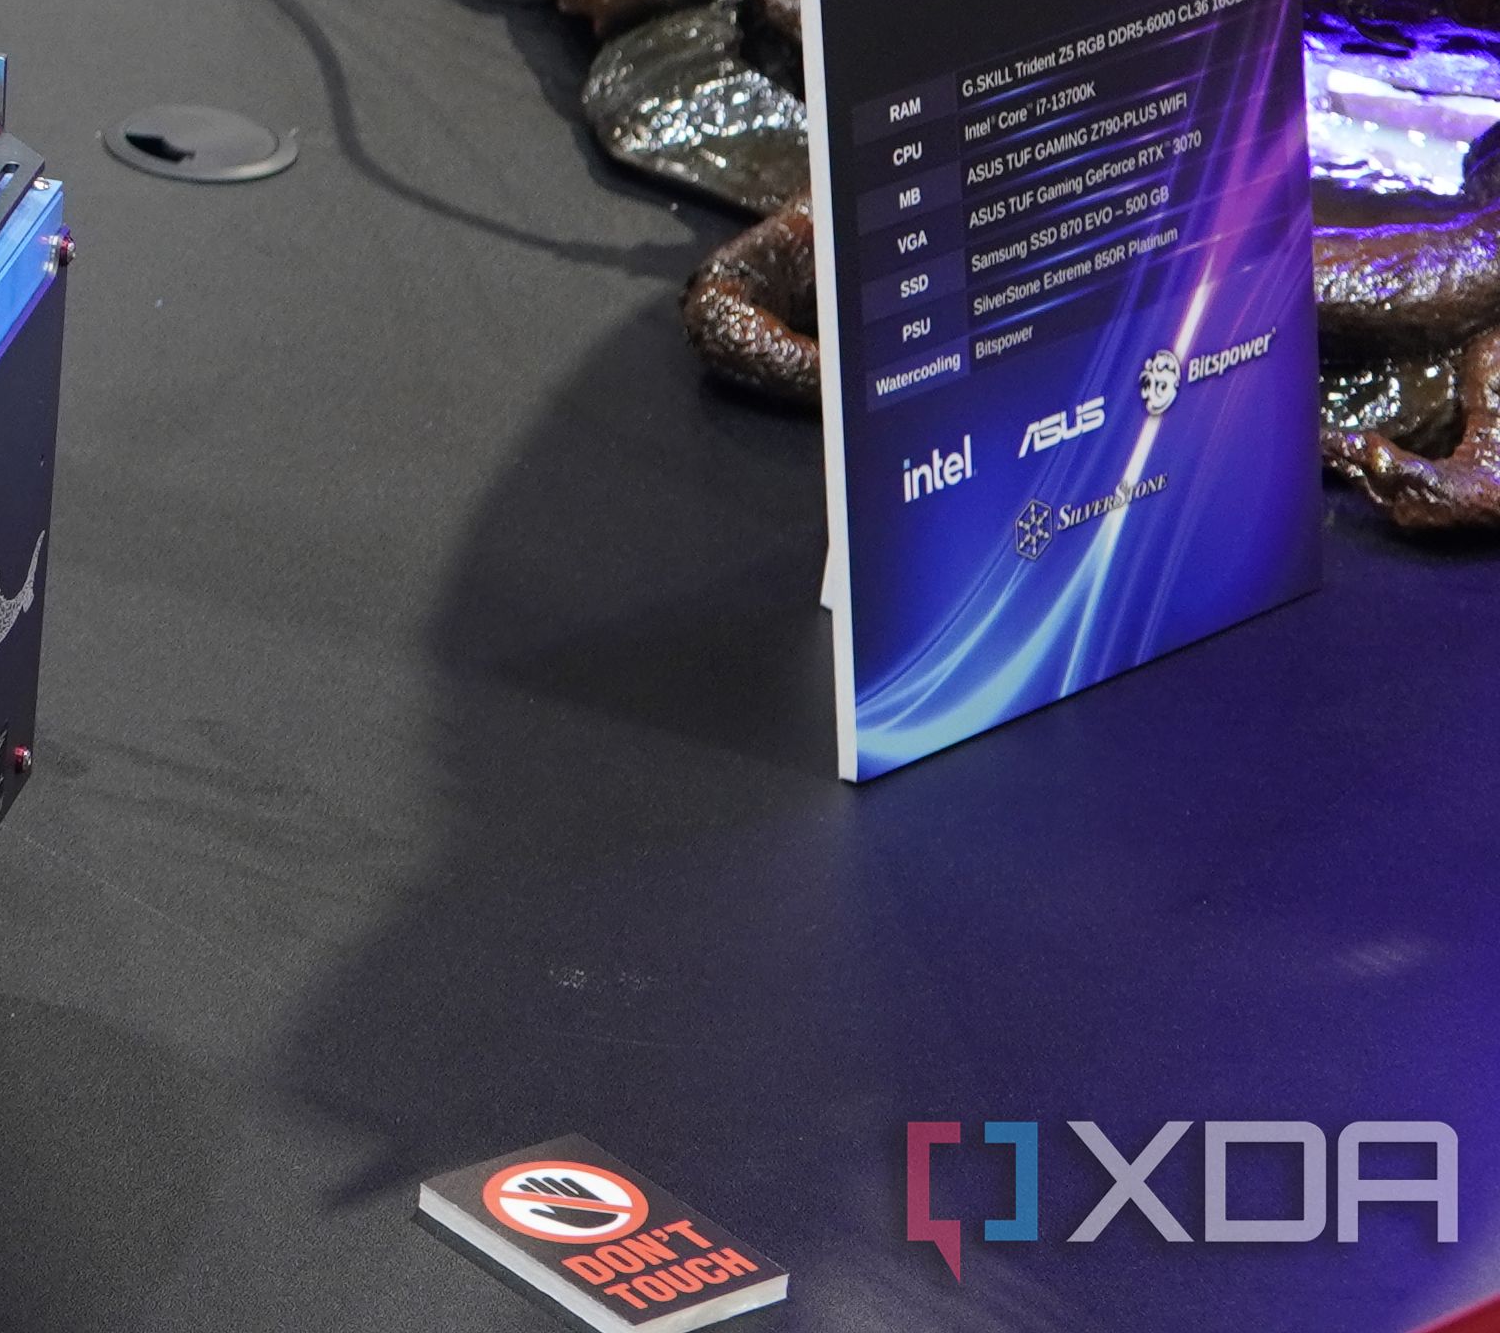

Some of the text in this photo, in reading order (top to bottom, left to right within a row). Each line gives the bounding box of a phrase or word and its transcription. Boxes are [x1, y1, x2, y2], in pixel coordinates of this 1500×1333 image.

[962, 66, 1014, 97] G.SKILL
[1015, 48, 1055, 80] Trident
[1058, 43, 1074, 63] Z5
[1077, 33, 1105, 59] RGB
[1109, 8, 1176, 49] DDR5-6000
[890, 98, 920, 123] RAM
[1036, 81, 1097, 121] i7-13700K
[893, 142, 922, 166] CPU
[967, 91, 1187, 185] ASUS TUF GAMING Z790-PLUS WIFI
[900, 186, 921, 210] MB
[969, 201, 1005, 229] ASUS
[1008, 190, 1034, 216] TUF
[1037, 174, 1083, 207] Gaming
[1085, 154, 1135, 187] GeForce
[1173, 131, 1201, 157] 3070
[898, 229, 928, 254] VGA
[972, 239, 1027, 272] Samsung
[1030, 227, 1057, 252] SSD
[1060, 218, 1082, 242] 870
[1085, 208, 1112, 232] EVO
[1126, 195, 1148, 217] 500
[1151, 186, 1169, 207] GB
[900, 273, 928, 298] SSD
[974, 227, 1177, 316] SilverStone Extreme 850R Platinum
[902, 317, 930, 342] PSU
[975, 325, 1033, 360] Bitspower
[876, 349, 961, 397] Watercooling
[1019, 397, 1105, 459] ASUS
[903, 434, 975, 502] intel
[561, 1219, 713, 1285] DON'T
[603, 1247, 759, 1309] TOUCH
